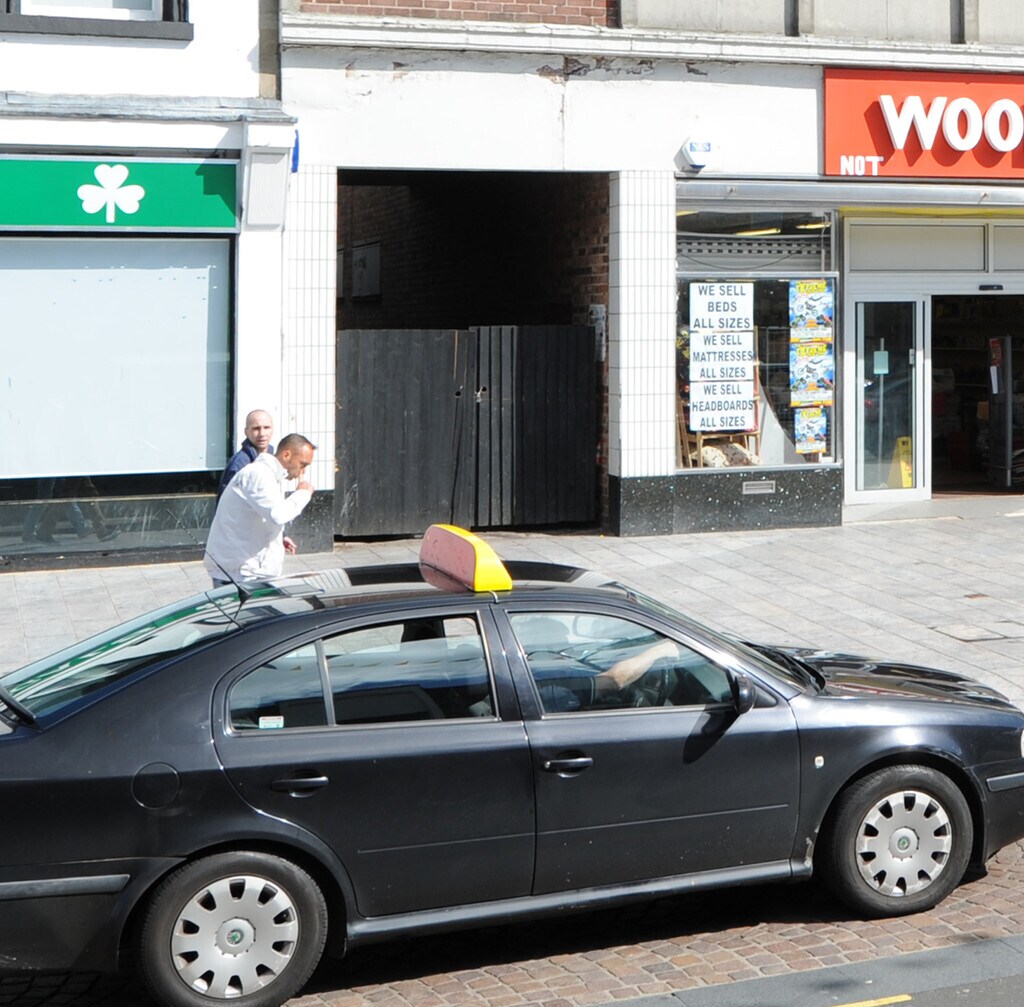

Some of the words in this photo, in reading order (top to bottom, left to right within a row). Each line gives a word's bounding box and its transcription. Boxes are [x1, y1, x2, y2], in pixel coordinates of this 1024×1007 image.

[840, 155, 883, 176] NOT
[698, 285, 716, 296] WE
[719, 285, 746, 296] SELL
[707, 301, 737, 312] BEDS
[693, 318, 714, 328] ALL
[718, 318, 750, 328] SIZES
[703, 335, 717, 345] WE
[720, 335, 742, 345] SELL
[692, 351, 753, 362] MATTRESSES
[700, 368, 716, 378] ALL
[719, 367, 746, 378] SIZES
[703, 385, 717, 395] WE
[720, 384, 742, 395] SELL
[692, 400, 754, 412] HEADBOARDS
[700, 417, 716, 427] ALL
[719, 416, 746, 427] SIZES
